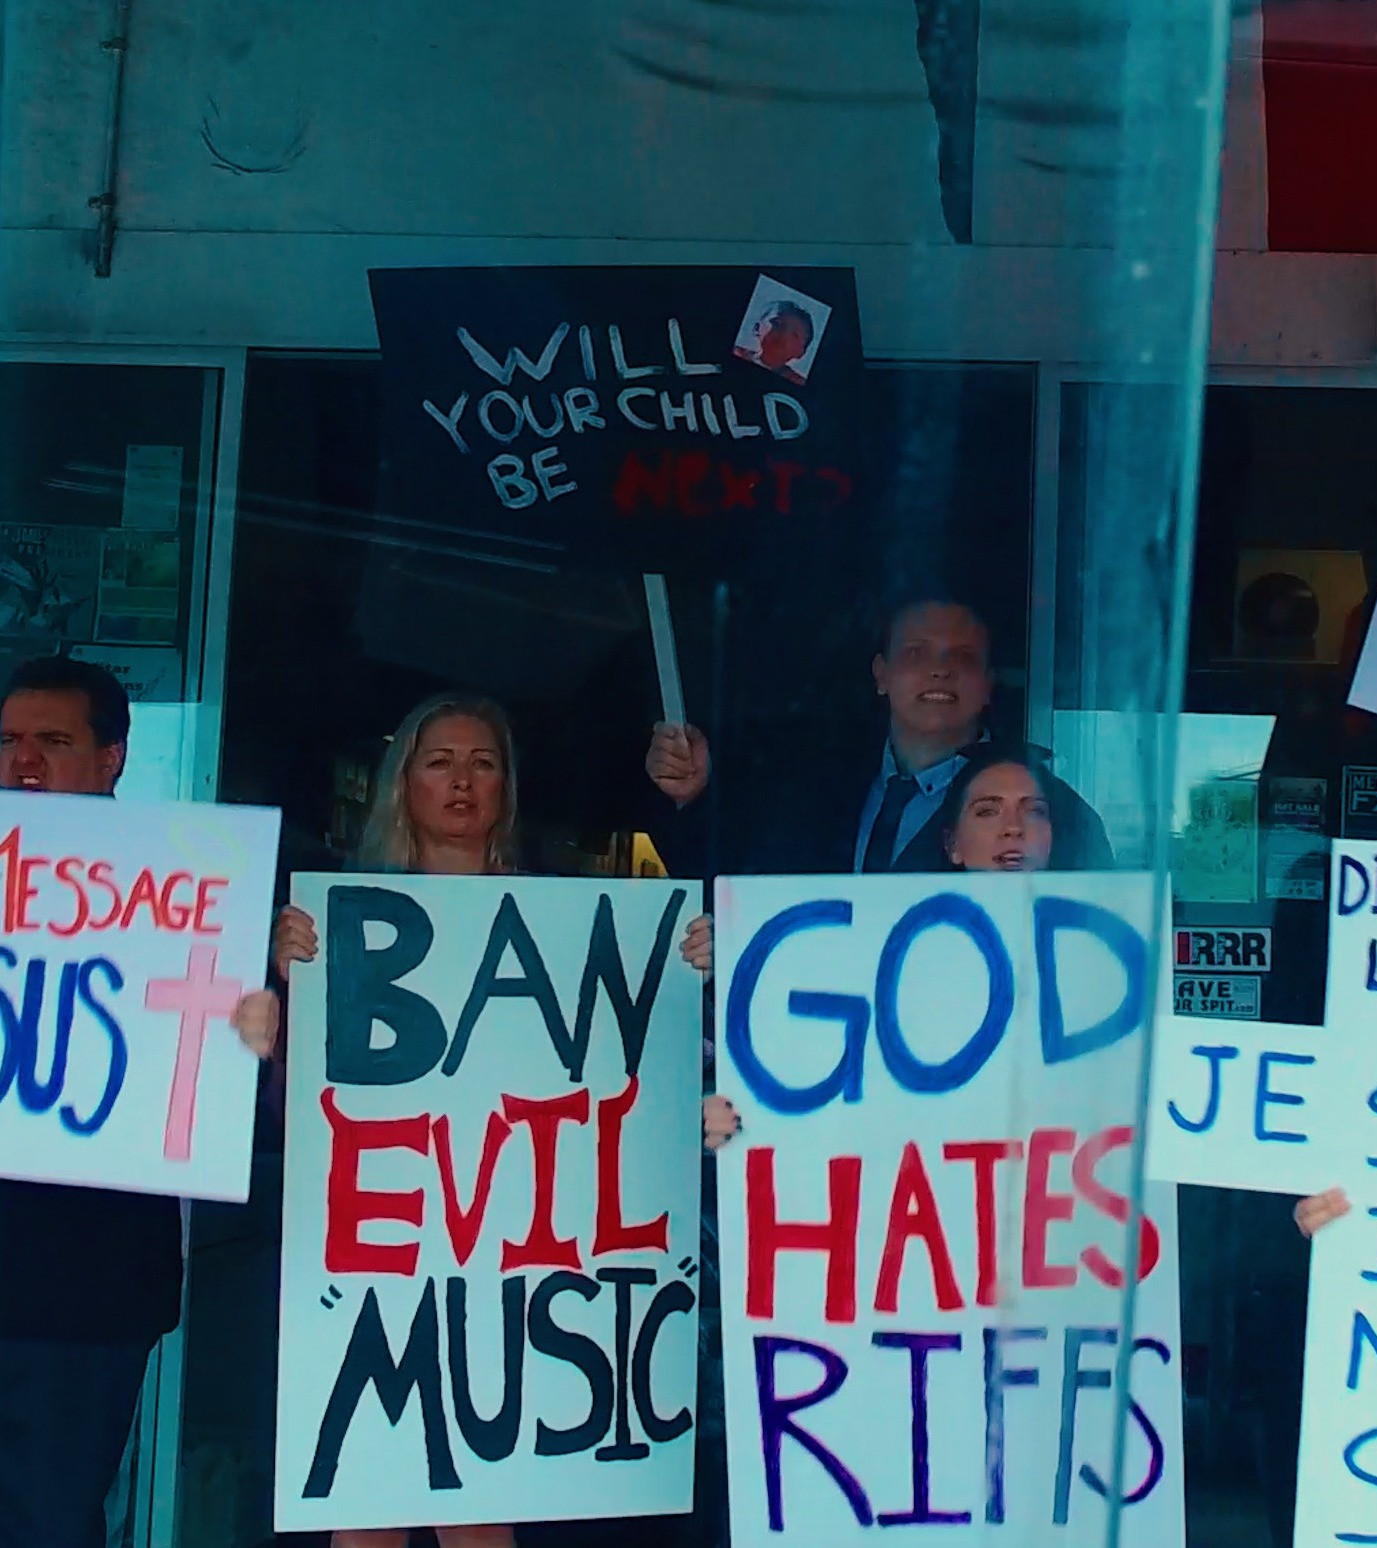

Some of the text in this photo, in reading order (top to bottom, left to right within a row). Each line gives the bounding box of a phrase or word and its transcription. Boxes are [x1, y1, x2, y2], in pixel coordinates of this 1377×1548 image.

[422, 386, 809, 454] YOUR CHILD
[457, 317, 722, 386] WILL
[487, 446, 578, 509] BE
[326, 885, 688, 1084] BAN
[725, 892, 1152, 1115] GOD
[320, 1076, 670, 1276] EVIL
[745, 1126, 1160, 1323] HATES
[302, 1256, 700, 1499] "MUSIC"
[753, 1327, 1171, 1532] RIFFS
